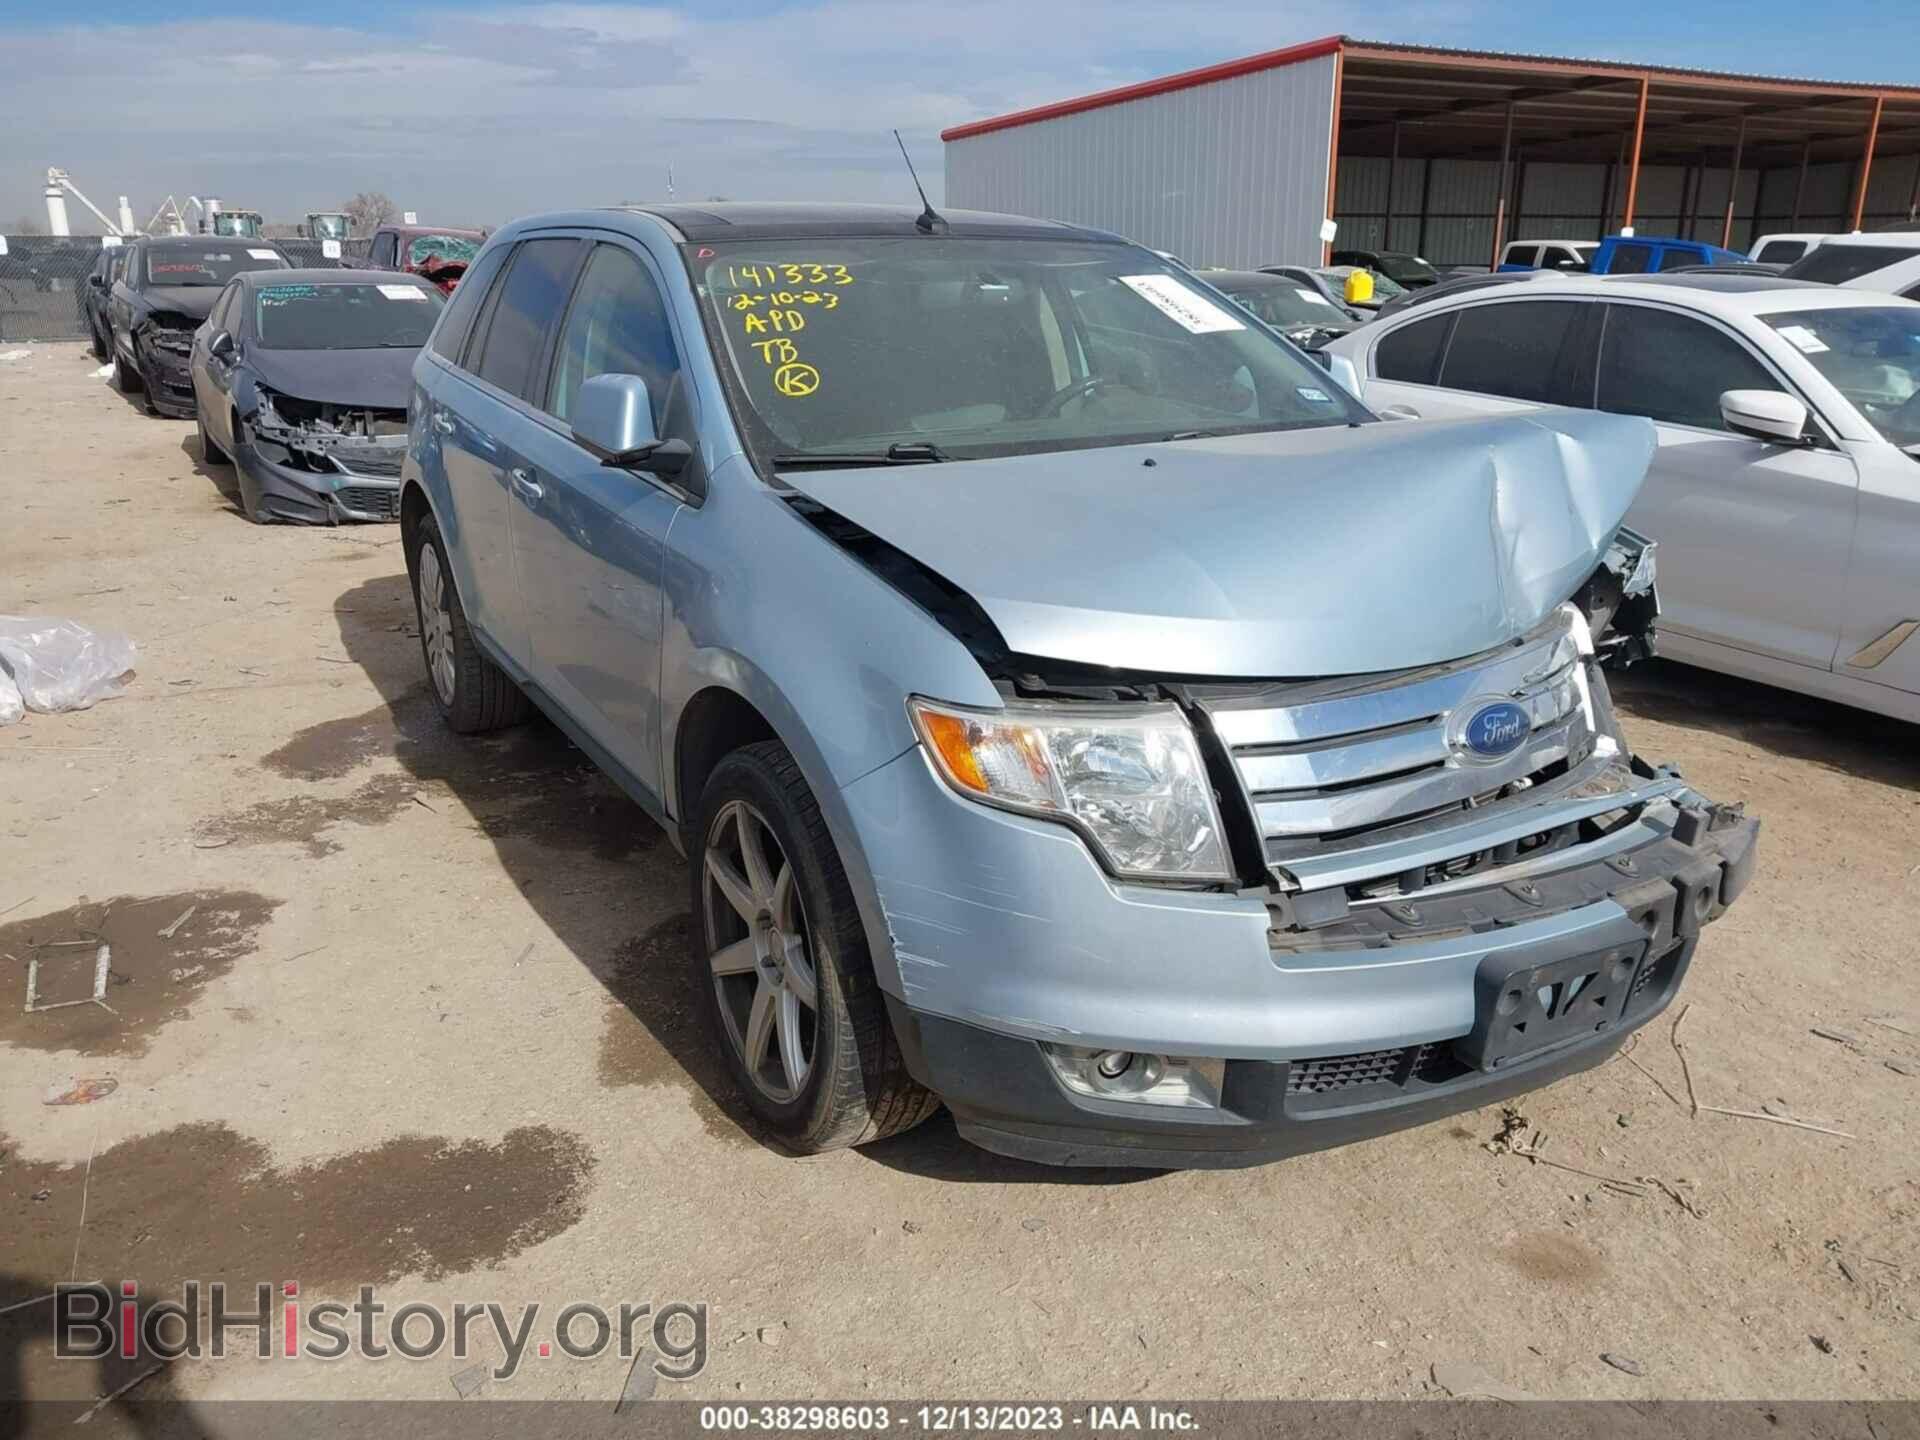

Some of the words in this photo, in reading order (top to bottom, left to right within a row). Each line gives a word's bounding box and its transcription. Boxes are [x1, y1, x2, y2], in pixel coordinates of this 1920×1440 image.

[728, 263, 854, 288] 141333
[726, 290, 840, 310] 12-10-23
[745, 309, 806, 334] APD
[751, 338, 798, 364] TB
[783, 368, 814, 394] K
[1483, 711, 1521, 743] Ford
